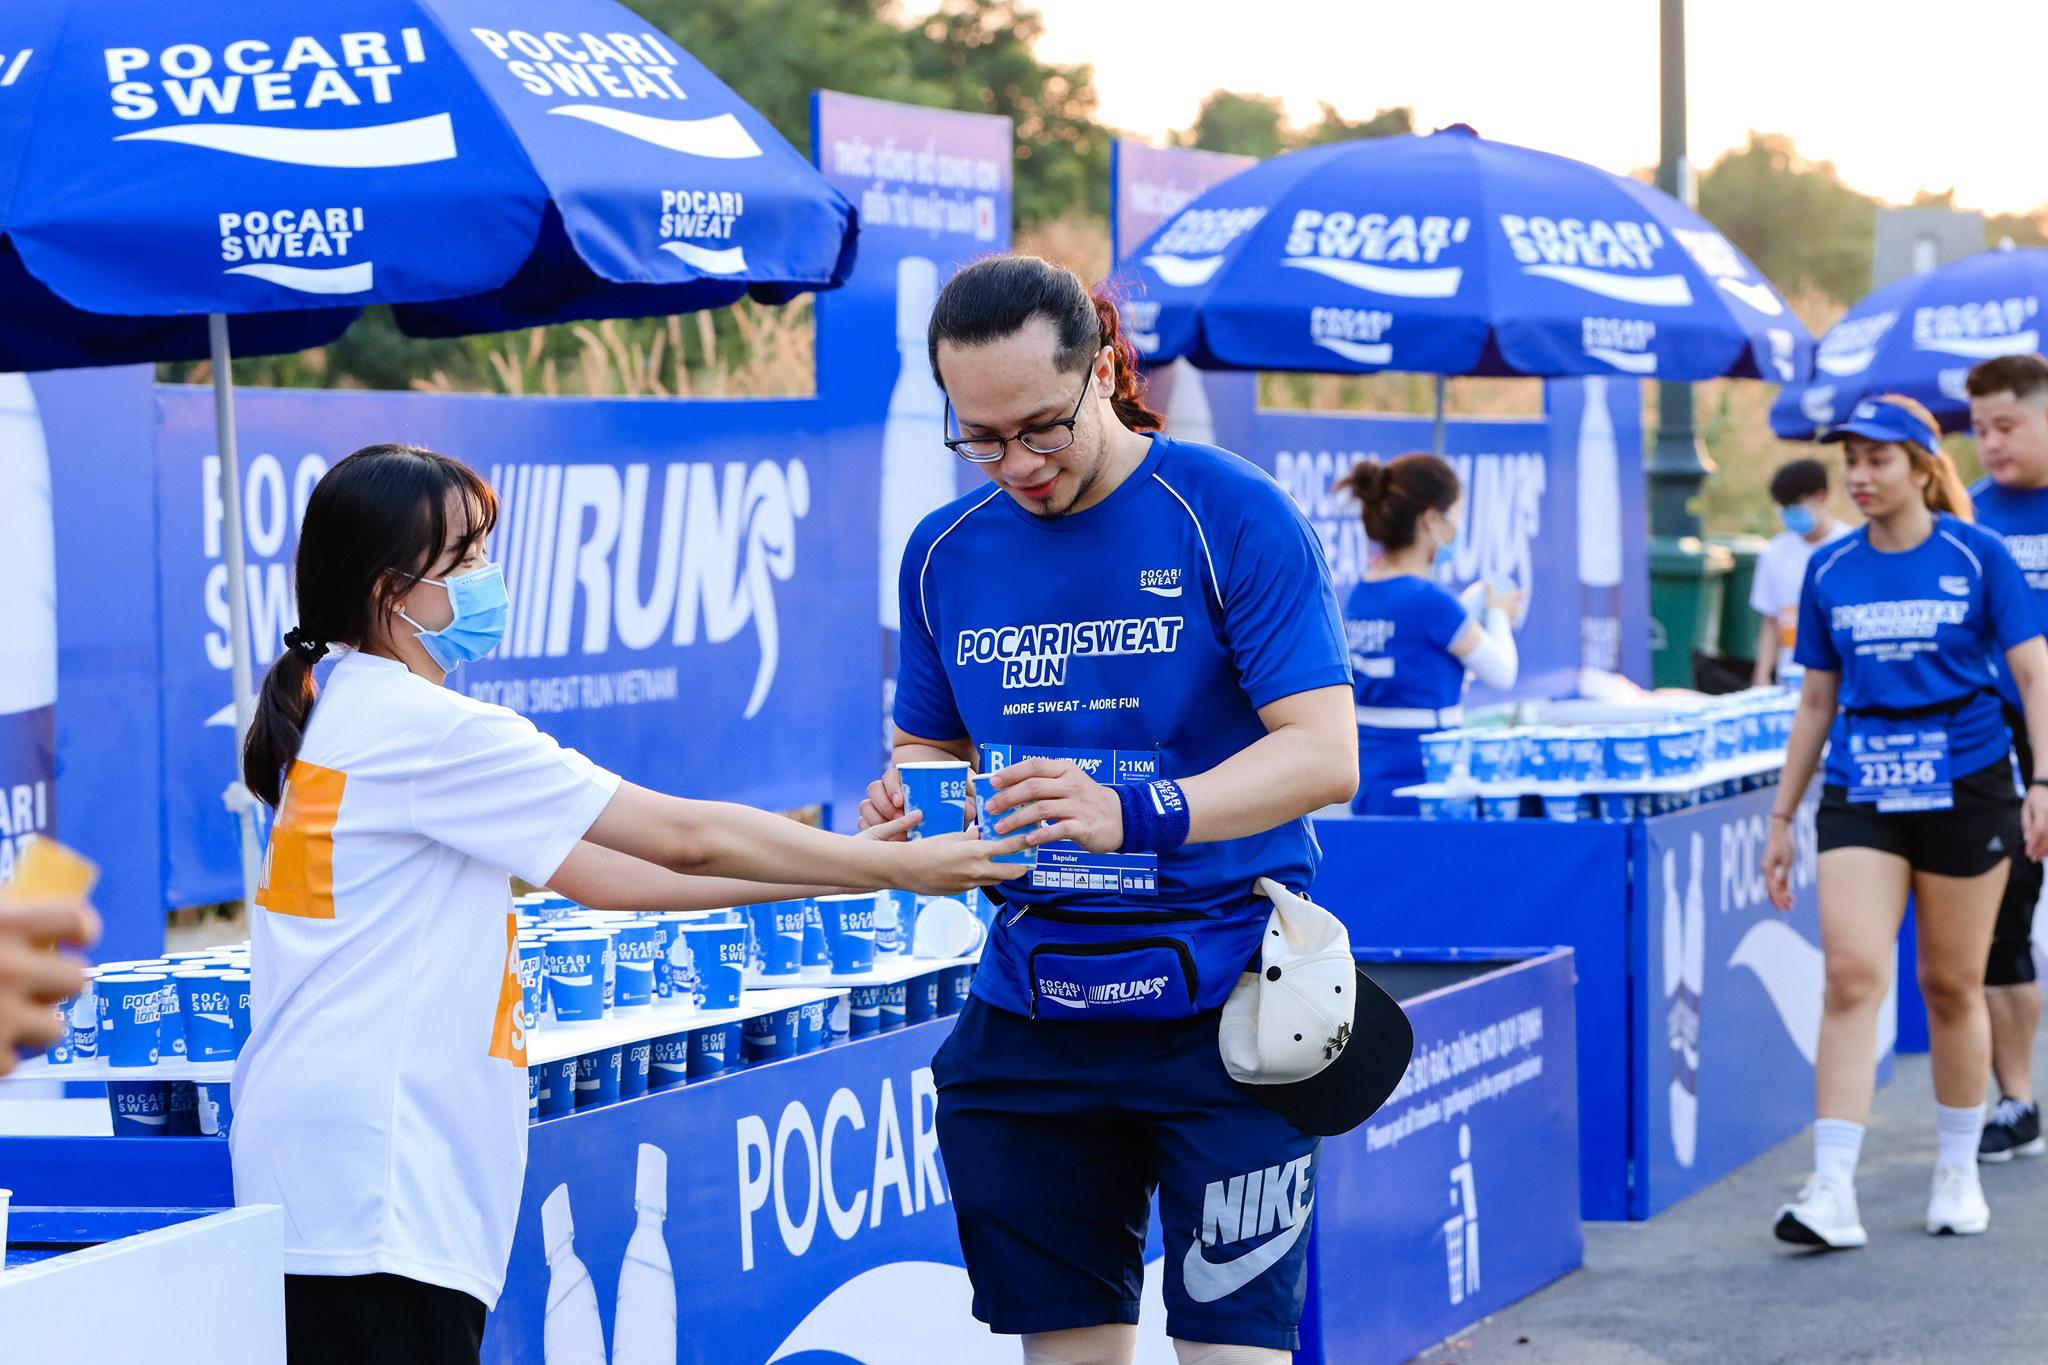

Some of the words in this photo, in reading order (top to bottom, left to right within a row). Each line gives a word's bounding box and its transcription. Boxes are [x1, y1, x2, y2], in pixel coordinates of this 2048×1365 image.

[104, 27, 426, 83] POCARI
[470, 28, 679, 65] POCARI
[110, 65, 402, 120] SWEAT
[507, 60, 688, 100] SWEAT
[661, 190, 743, 216] POCARI
[219, 207, 365, 236] POCARI
[659, 214, 736, 239] SWEAT
[1291, 209, 1471, 247] POCARI
[1501, 215, 1663, 249] POCARI
[221, 232, 353, 262] SWEAT
[1285, 231, 1445, 263] SWEAT
[1512, 238, 1654, 269] SWEAT
[1140, 568, 1181, 579] POCARI
[1140, 577, 1178, 587] SWEAT
[957, 622, 1073, 666] POCARI
[1071, 616, 1184, 656] SWEAT
[1003, 656, 1067, 689] RUN
[1003, 703, 1035, 716] MORE
[1037, 700, 1080, 713] SWEAT
[1089, 698, 1118, 710] MORE
[1119, 697, 1140, 709] FUN
[1119, 760, 1154, 772] 21KM
[940, 781, 967, 790] POC
[940, 789, 967, 799] SWE
[0, 780, 47, 836] ARI
[776, 914, 804, 924] POC
[840, 912, 874, 923] POCA
[840, 920, 874, 930] SWEA
[619, 949, 653, 960] WEAT
[720, 944, 745, 952] POC
[1039, 978, 1080, 992] POCARI
[1041, 985, 1078, 997] SWEAT
[736, 1066, 953, 1272] POCAR
[1202, 1153, 1312, 1248] NIKE
